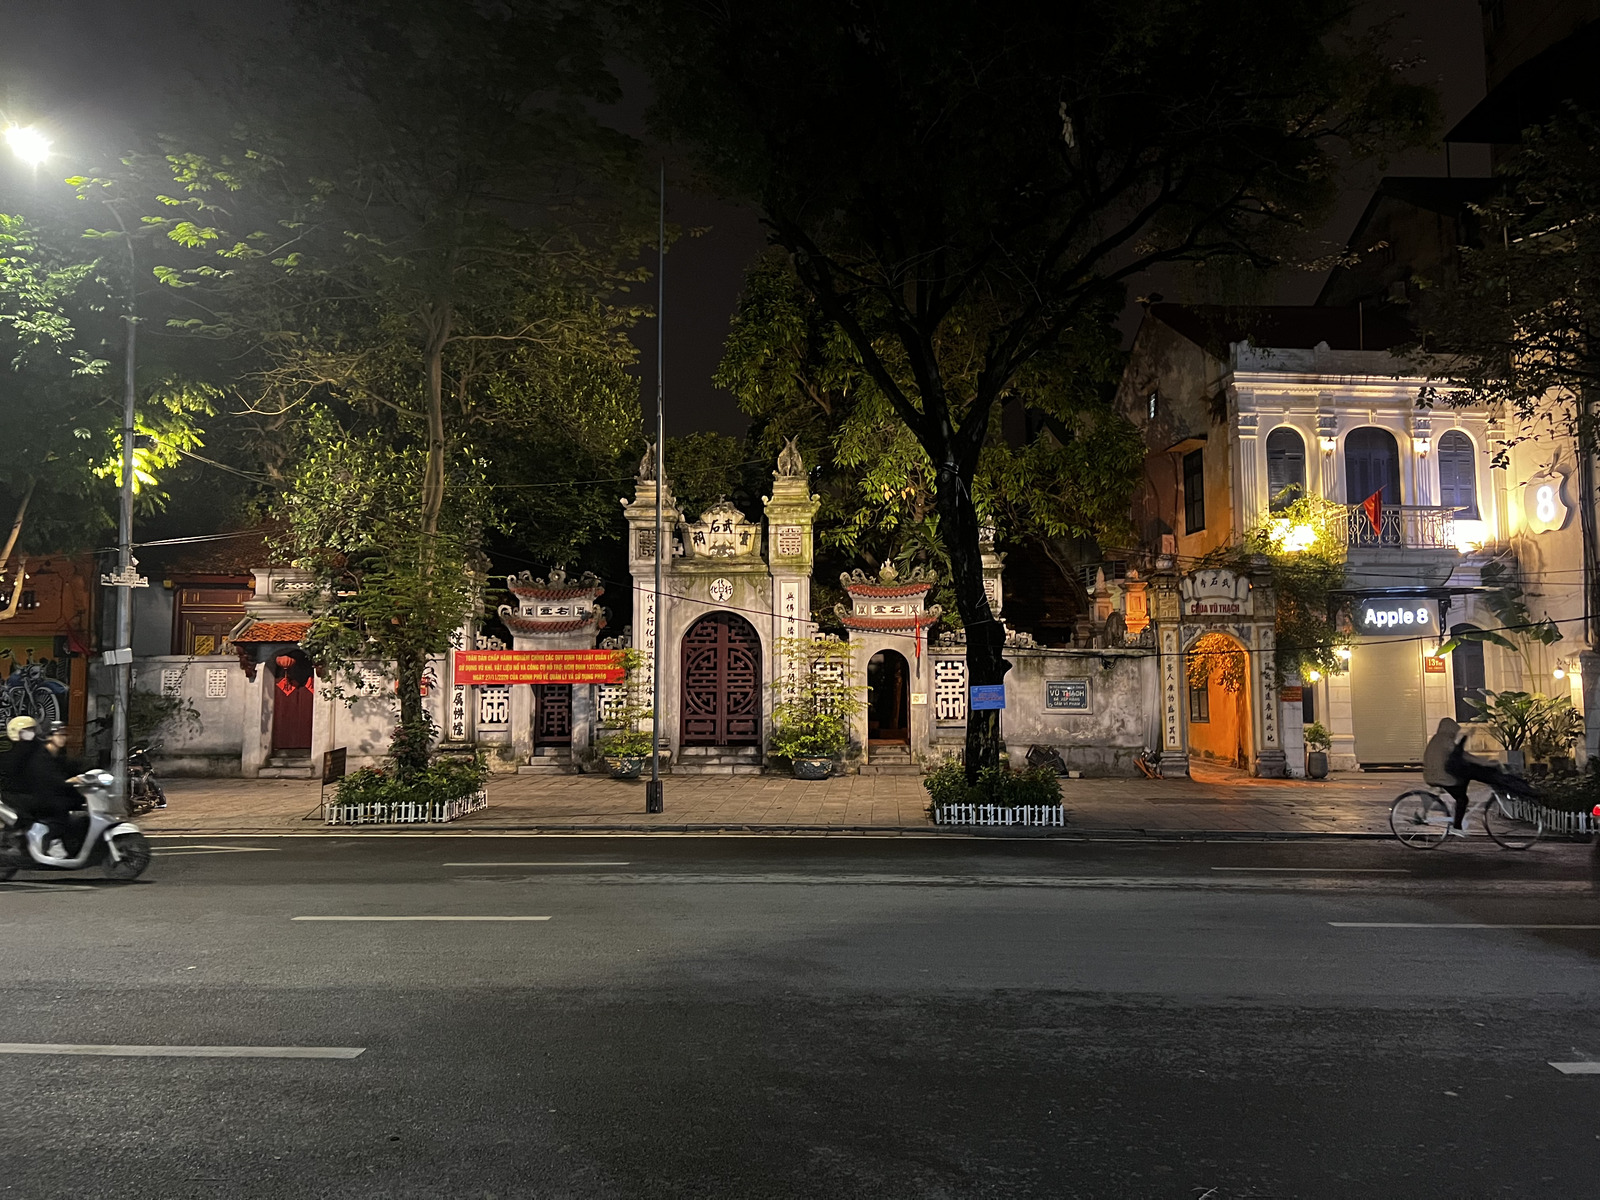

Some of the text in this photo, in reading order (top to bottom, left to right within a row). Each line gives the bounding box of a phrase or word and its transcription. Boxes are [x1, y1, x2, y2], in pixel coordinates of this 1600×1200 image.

[1537, 486, 1554, 522] 8
[1191, 602, 1240, 614] CHÙA VŨ THẠCH
[1364, 608, 1429, 628] Apple 8
